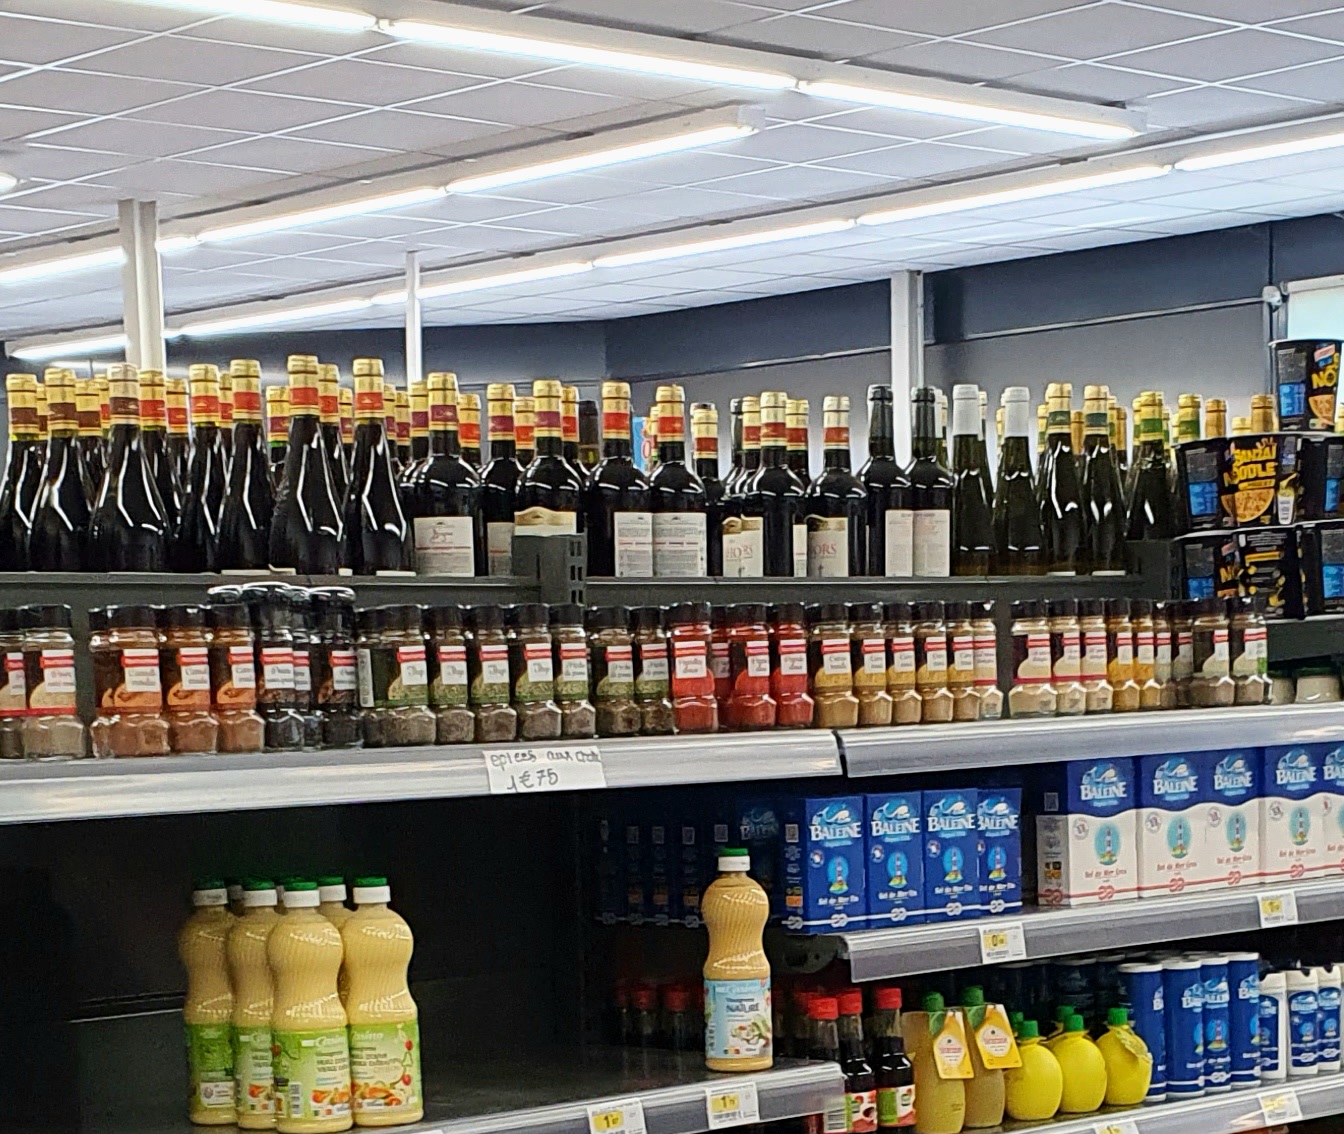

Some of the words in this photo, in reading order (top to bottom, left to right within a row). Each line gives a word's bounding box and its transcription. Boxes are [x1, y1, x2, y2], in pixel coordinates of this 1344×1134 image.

[506, 768, 559, 793] 1€75
[1153, 776, 1198, 794] BALEINE
[1214, 771, 1253, 790] BALEINE
[1276, 766, 1317, 785] BALEINE
[1080, 782, 1127, 801] BALEINE
[809, 822, 862, 842] BALEINE
[871, 817, 920, 838] BALEINE
[927, 813, 976, 833] BALEINE
